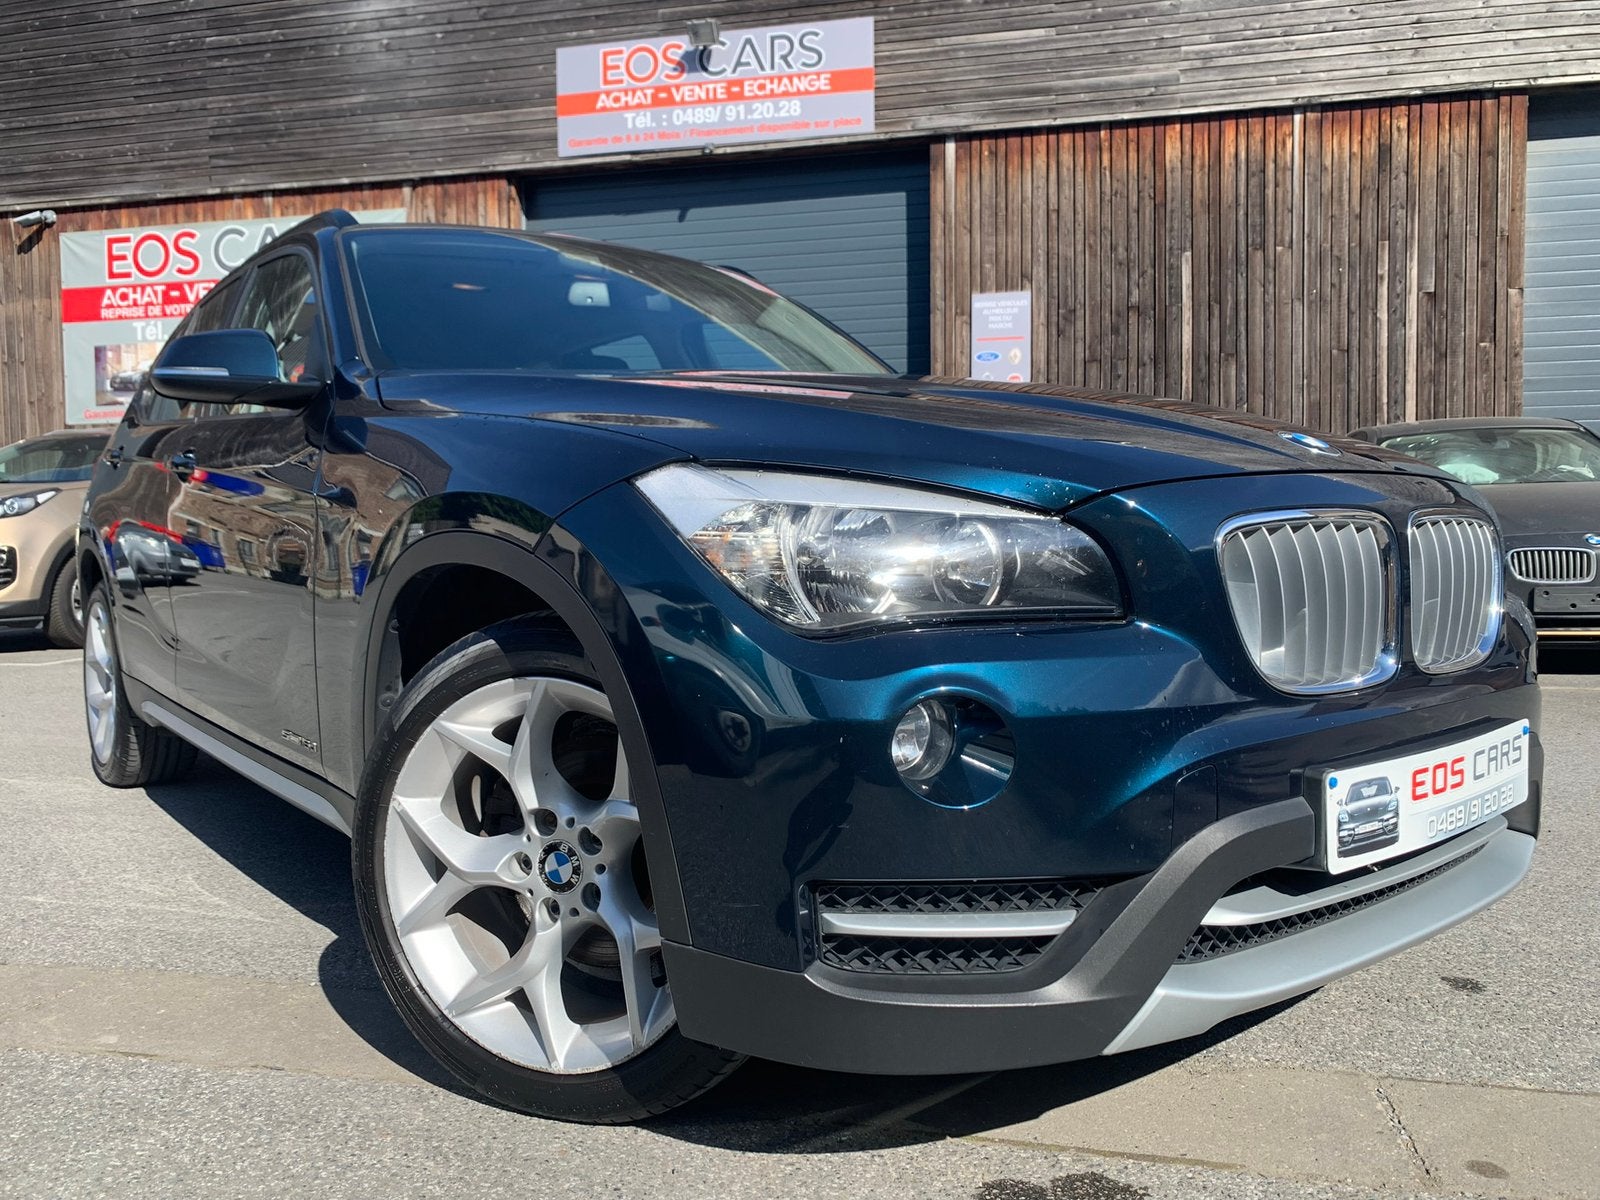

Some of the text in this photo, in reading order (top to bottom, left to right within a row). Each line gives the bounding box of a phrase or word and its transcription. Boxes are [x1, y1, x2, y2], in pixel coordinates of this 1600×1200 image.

[601, 30, 823, 87] EOS CARS
[596, 89, 654, 109] ACHAT
[671, 83, 728, 102] VENTE
[743, 74, 831, 97] ECHANGE
[624, 112, 656, 129] Tél.
[672, 106, 720, 126] 0489/
[725, 100, 802, 121] 91.20.28
[105, 229, 201, 281] EOS
[101, 306, 146, 319] REPRISE
[148, 304, 163, 316] DE
[102, 285, 166, 307] ACHAT
[1411, 733, 1522, 801] EOS CARS
